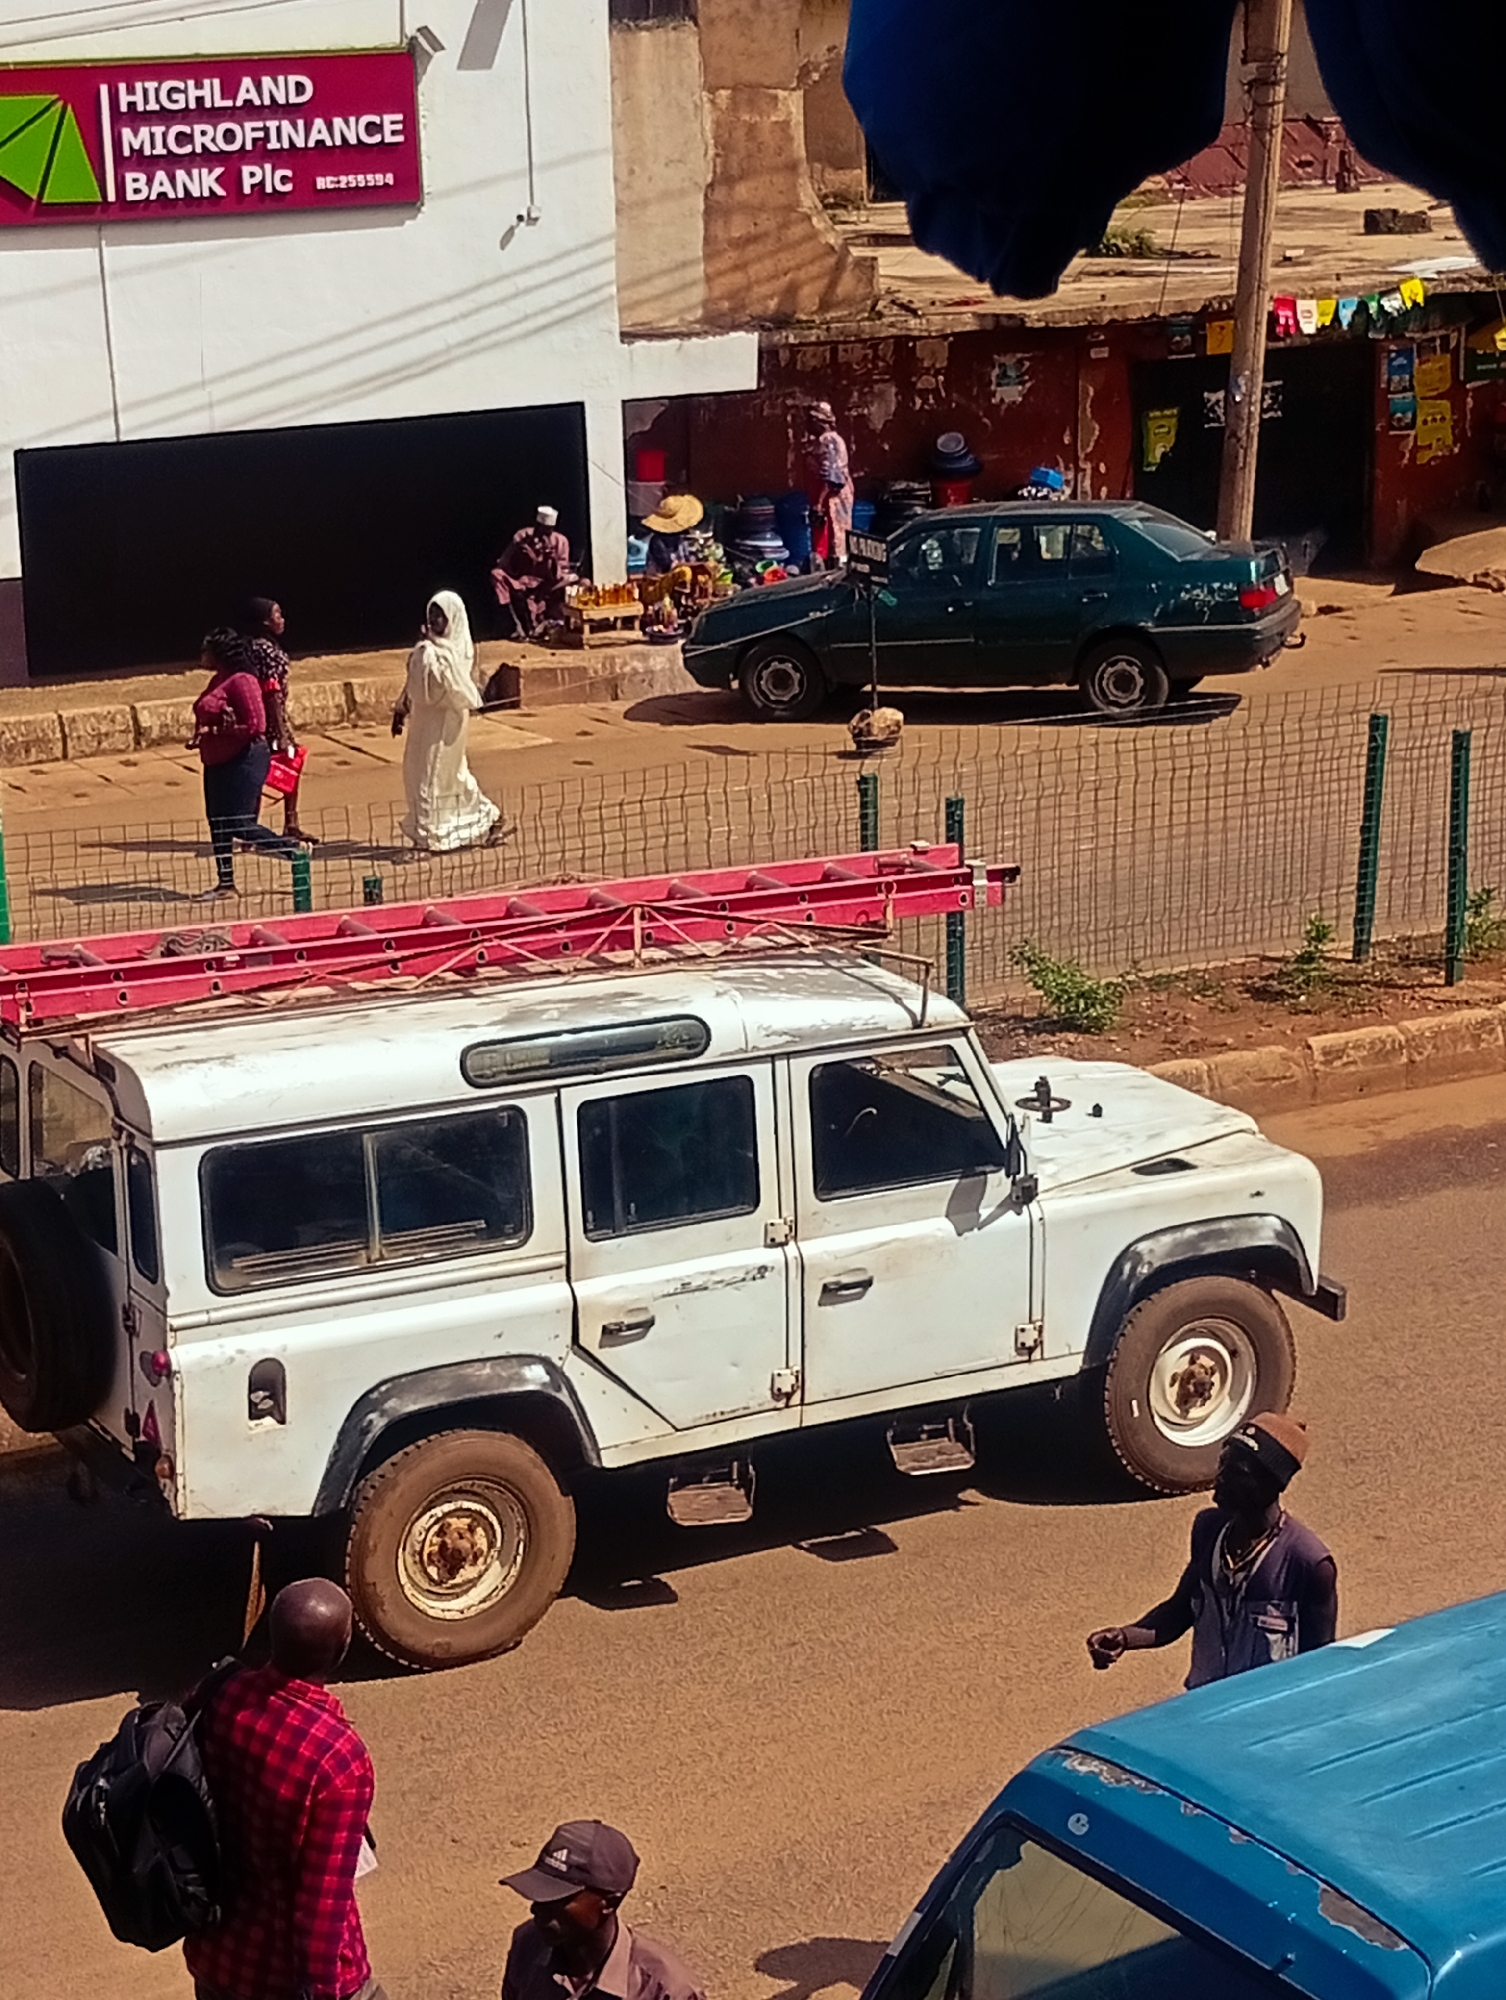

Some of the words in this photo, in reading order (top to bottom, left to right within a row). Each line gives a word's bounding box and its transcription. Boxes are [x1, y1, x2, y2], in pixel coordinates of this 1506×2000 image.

[118, 75, 314, 113] HIGHLAND
[121, 113, 405, 157] MICROFINANCE
[125, 166, 227, 202] BANK
[241, 163, 294, 195] Plc
